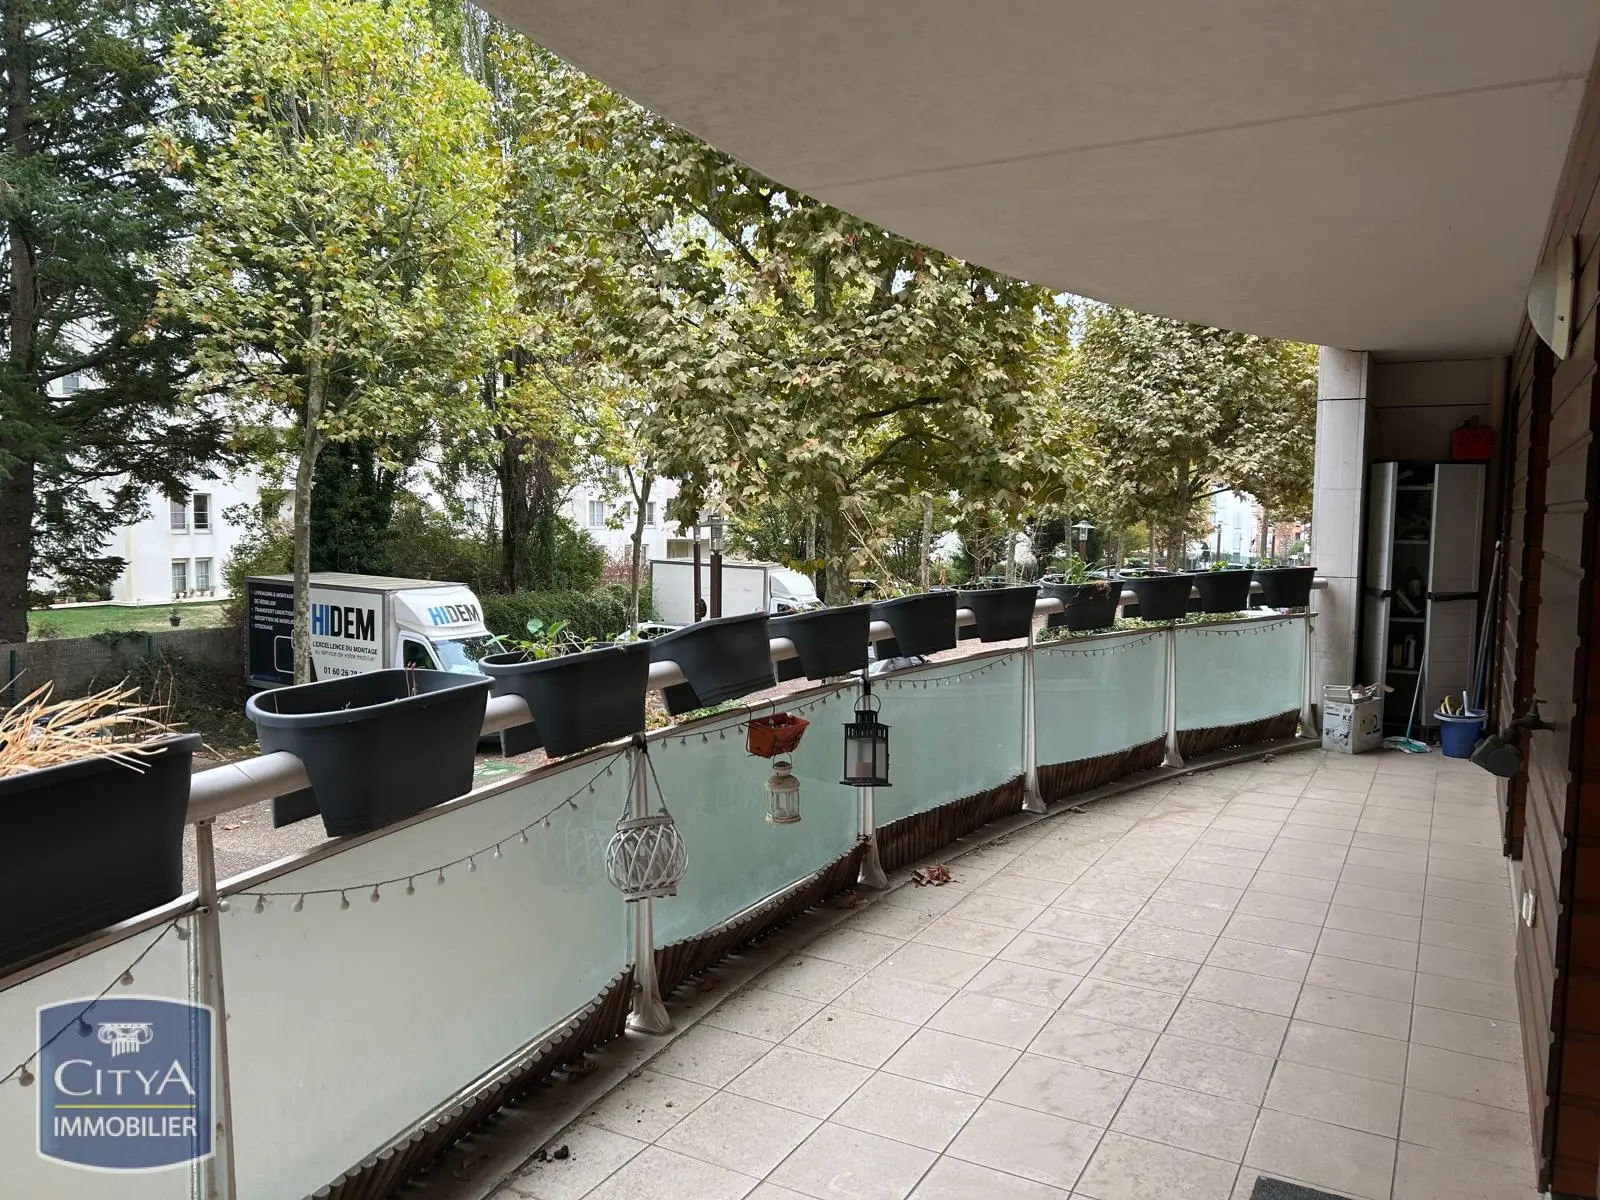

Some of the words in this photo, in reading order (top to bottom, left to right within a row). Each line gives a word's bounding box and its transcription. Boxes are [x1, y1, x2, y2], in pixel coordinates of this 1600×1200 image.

[312, 604, 375, 642] HIDEM
[427, 604, 480, 626] HIDEM
[312, 641, 344, 650] L'EXCELLENCE
[353, 646, 378, 655] MONTAGE
[332, 668, 340, 676] 60
